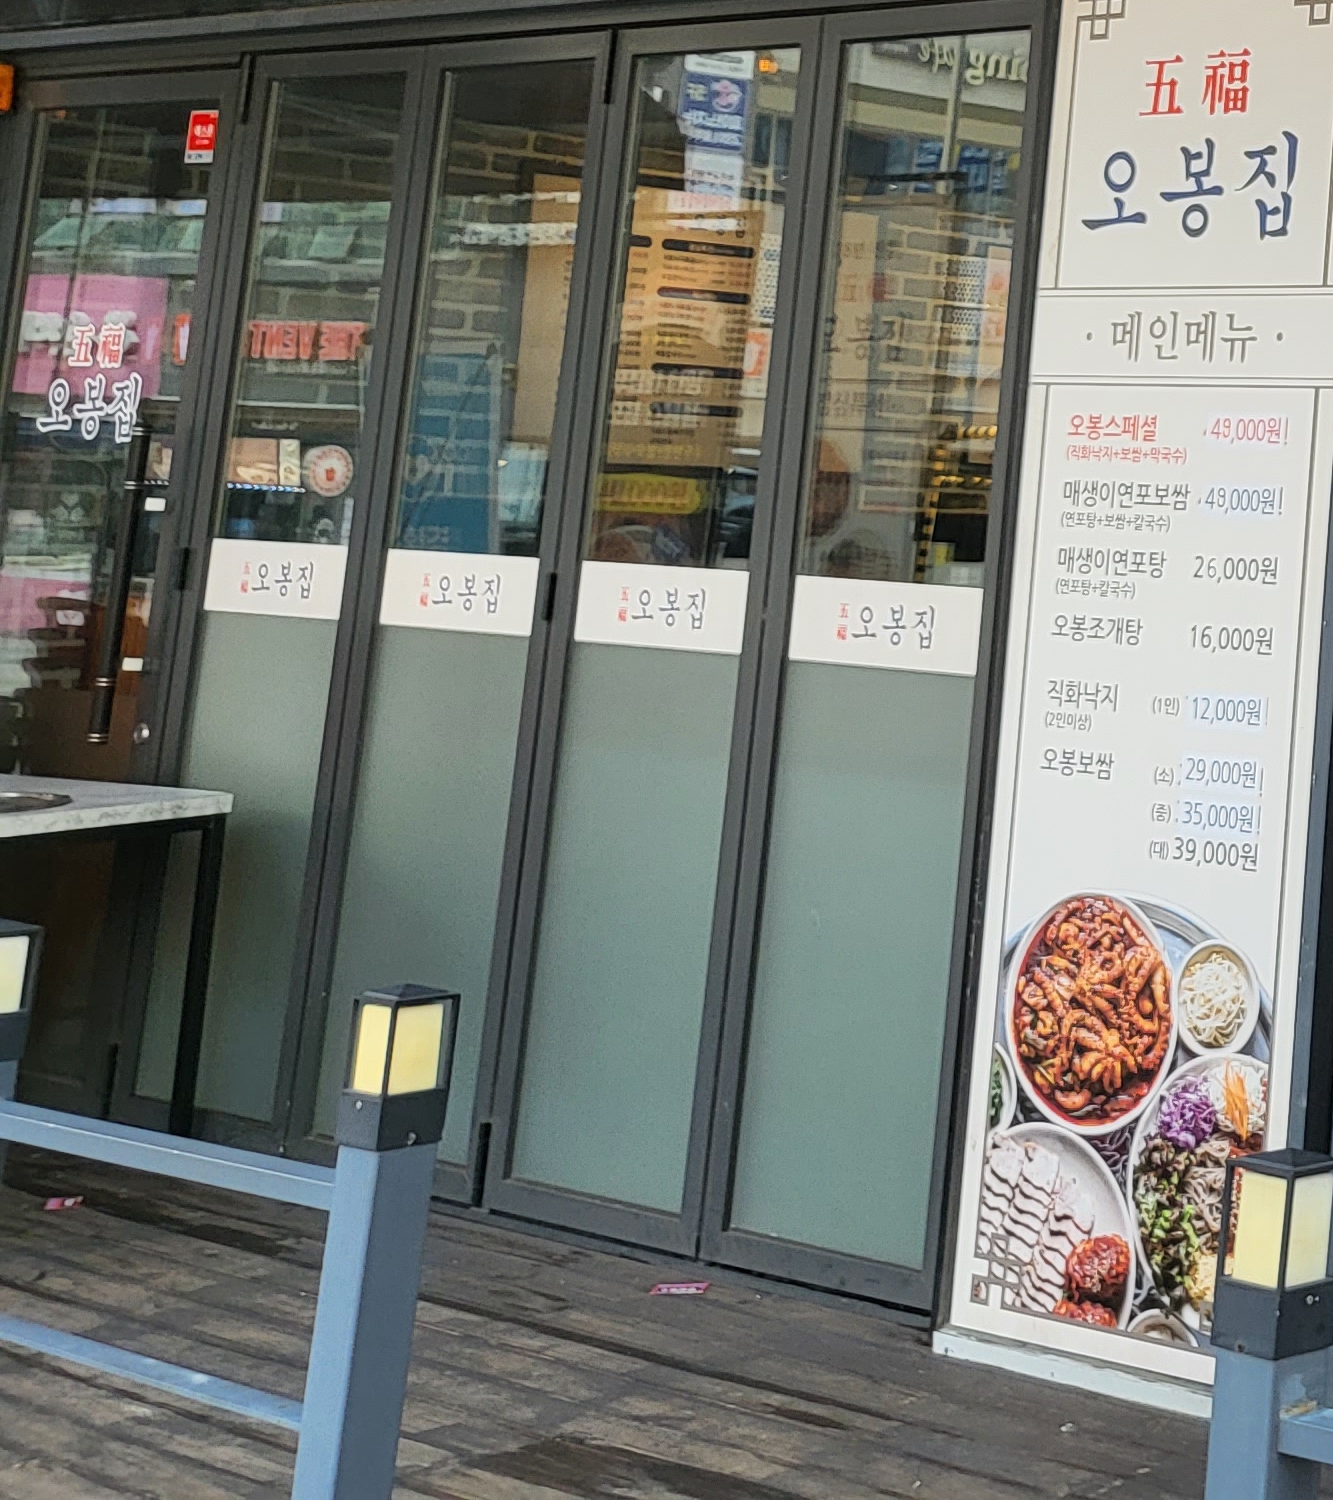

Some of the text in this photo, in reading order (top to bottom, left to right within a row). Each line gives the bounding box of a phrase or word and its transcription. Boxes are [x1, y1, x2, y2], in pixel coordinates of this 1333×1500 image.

[1139, 47, 1252, 117] 五福
[1081, 130, 1299, 241] 오봉집
[68, 322, 126, 369] 五福
[1111, 310, 1259, 363] 메인메뉴
[36, 372, 143, 444] 오봉집
[1067, 413, 1158, 442] 오봉스페셜
[1063, 479, 1192, 511] 매생이연포보쌈
[251, 560, 315, 601] 오봉집
[1057, 546, 1279, 585] 매생이연포탕 26,000원
[431, 573, 502, 614] 오봉집
[631, 587, 707, 631] 오봉집
[851, 604, 936, 651] 오봉집
[1051, 613, 1274, 656] 오봉조개탕 16,000원
[1045, 711, 1093, 733] (2인이상)
[1047, 679, 1262, 727] 직화낙지 (1인) 12,000원
[1040, 748, 1257, 789] 오봉보쌈 (소) 29,000원
[1181, 800, 1254, 834] 35,000원
[1149, 836, 1259, 873] (대) 39,000원
